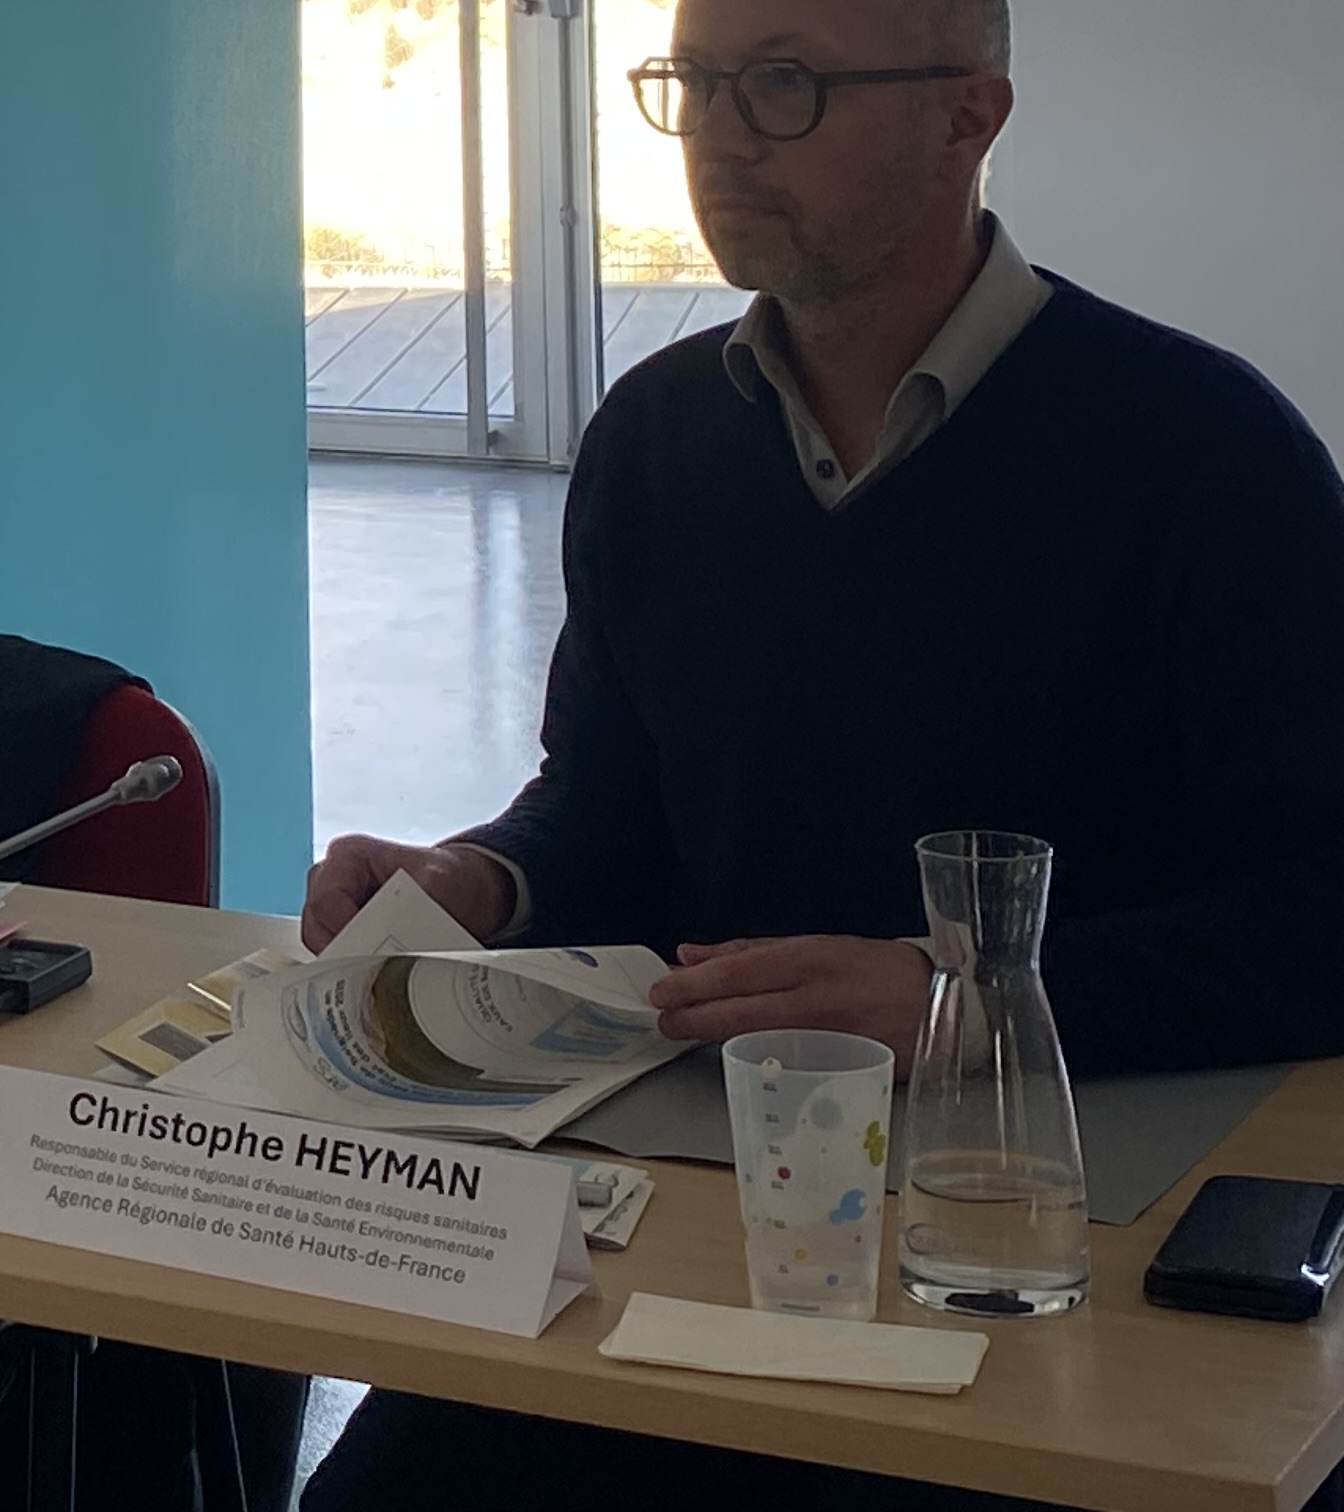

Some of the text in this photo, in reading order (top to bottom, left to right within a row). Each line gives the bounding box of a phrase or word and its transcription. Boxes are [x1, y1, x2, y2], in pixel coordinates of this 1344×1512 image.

[30, 1134, 508, 1240] Responsable du Service régional d'évaluation des risques sanitaires
[69, 1092, 481, 1201] Christophe HEYMAN
[32, 1156, 495, 1261] Direction de la Sécurité Sanitaire et de la Santé Environnementale
[46, 1184, 466, 1284] Agence Régionale de Santé Hauts-de-France
